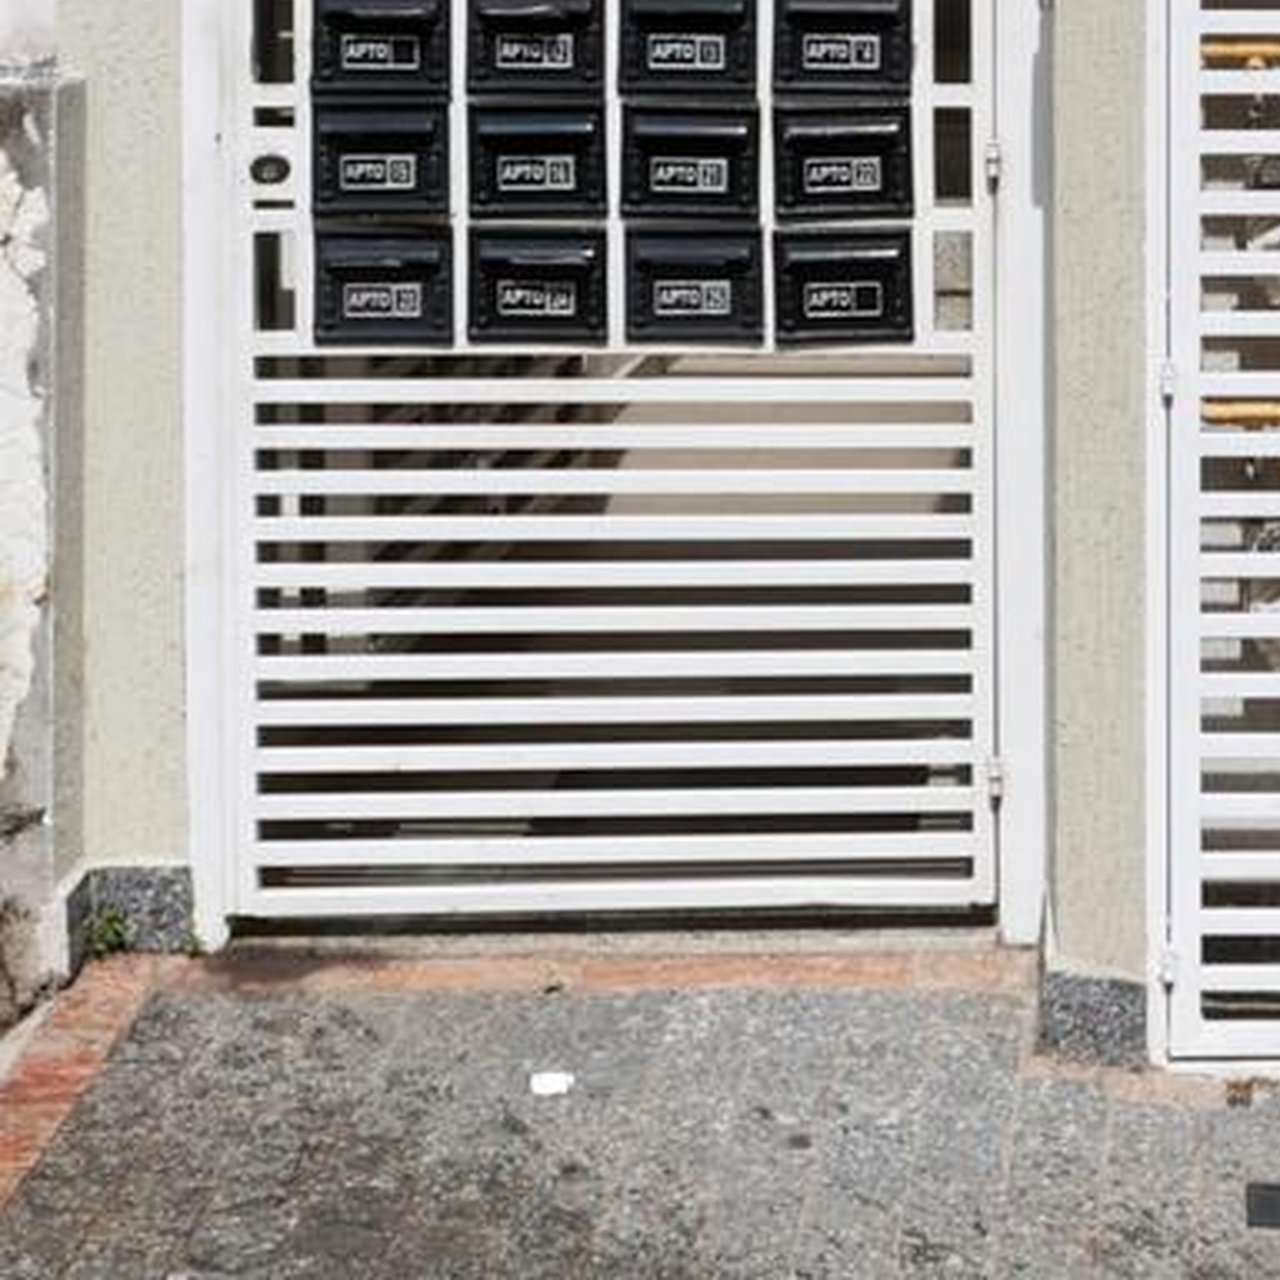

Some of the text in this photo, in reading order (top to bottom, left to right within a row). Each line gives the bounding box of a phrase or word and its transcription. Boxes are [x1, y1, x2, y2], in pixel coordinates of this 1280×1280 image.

[347, 43, 387, 59] APTO
[502, 43, 541, 59] APTO
[651, 43, 694, 59] APTO
[808, 43, 847, 59] APTO
[346, 162, 383, 178] APTO
[502, 164, 543, 180] APTO
[656, 165, 696, 182] APTO
[809, 165, 850, 182] APTO
[349, 292, 391, 309] APTO
[502, 289, 543, 305] APTO
[661, 289, 699, 304] APTO
[810, 291, 849, 307] APTO
